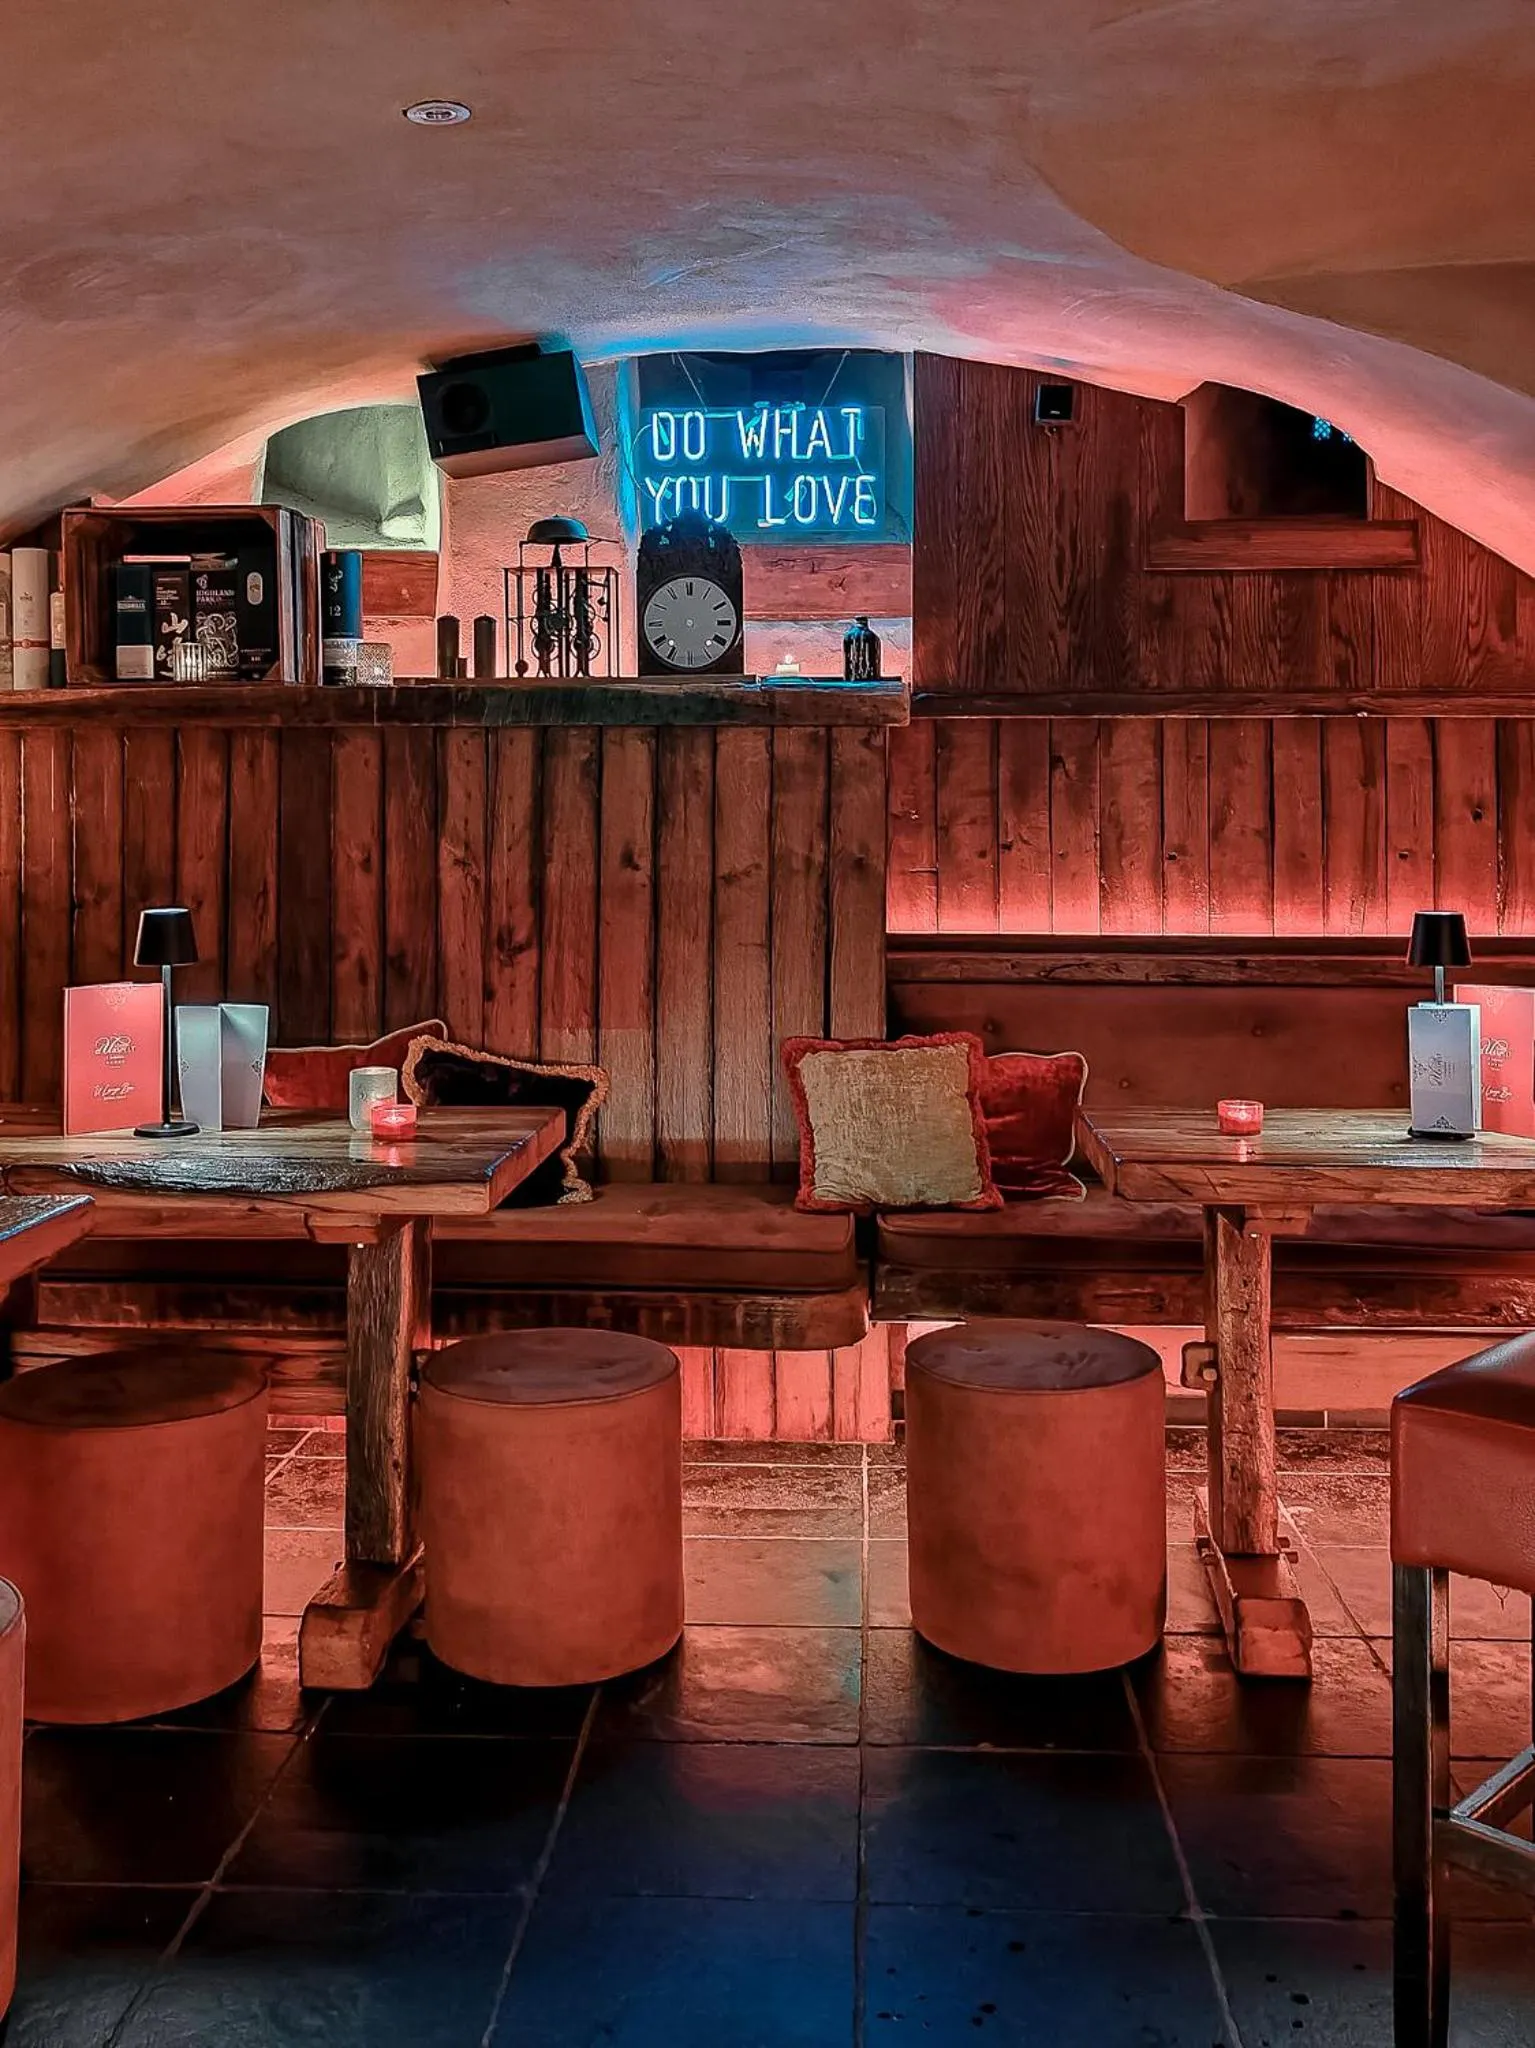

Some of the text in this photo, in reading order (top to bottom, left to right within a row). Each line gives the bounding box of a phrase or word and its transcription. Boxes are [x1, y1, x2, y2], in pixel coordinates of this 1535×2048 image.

[652, 408, 862, 461] DO WHAT
[644, 475, 877, 526] YOU LOVE
[329, 605, 342, 617] 12
